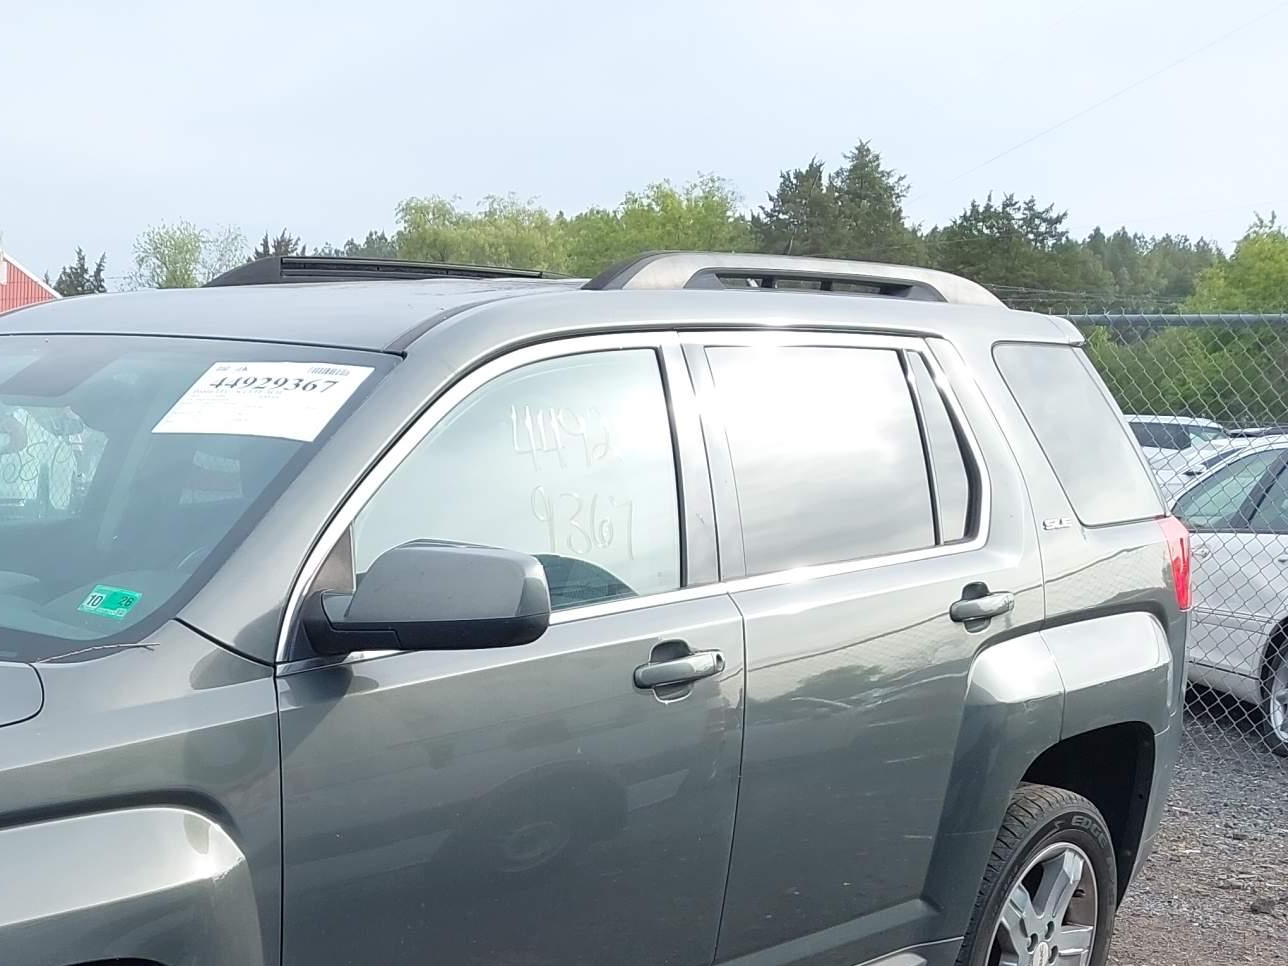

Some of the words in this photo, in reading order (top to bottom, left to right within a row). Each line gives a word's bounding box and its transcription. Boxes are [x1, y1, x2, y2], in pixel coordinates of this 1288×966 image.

[209, 376, 339, 393] 44929367
[511, 404, 610, 472] 4492
[86, 594, 103, 607] 10
[119, 596, 135, 607] 26
